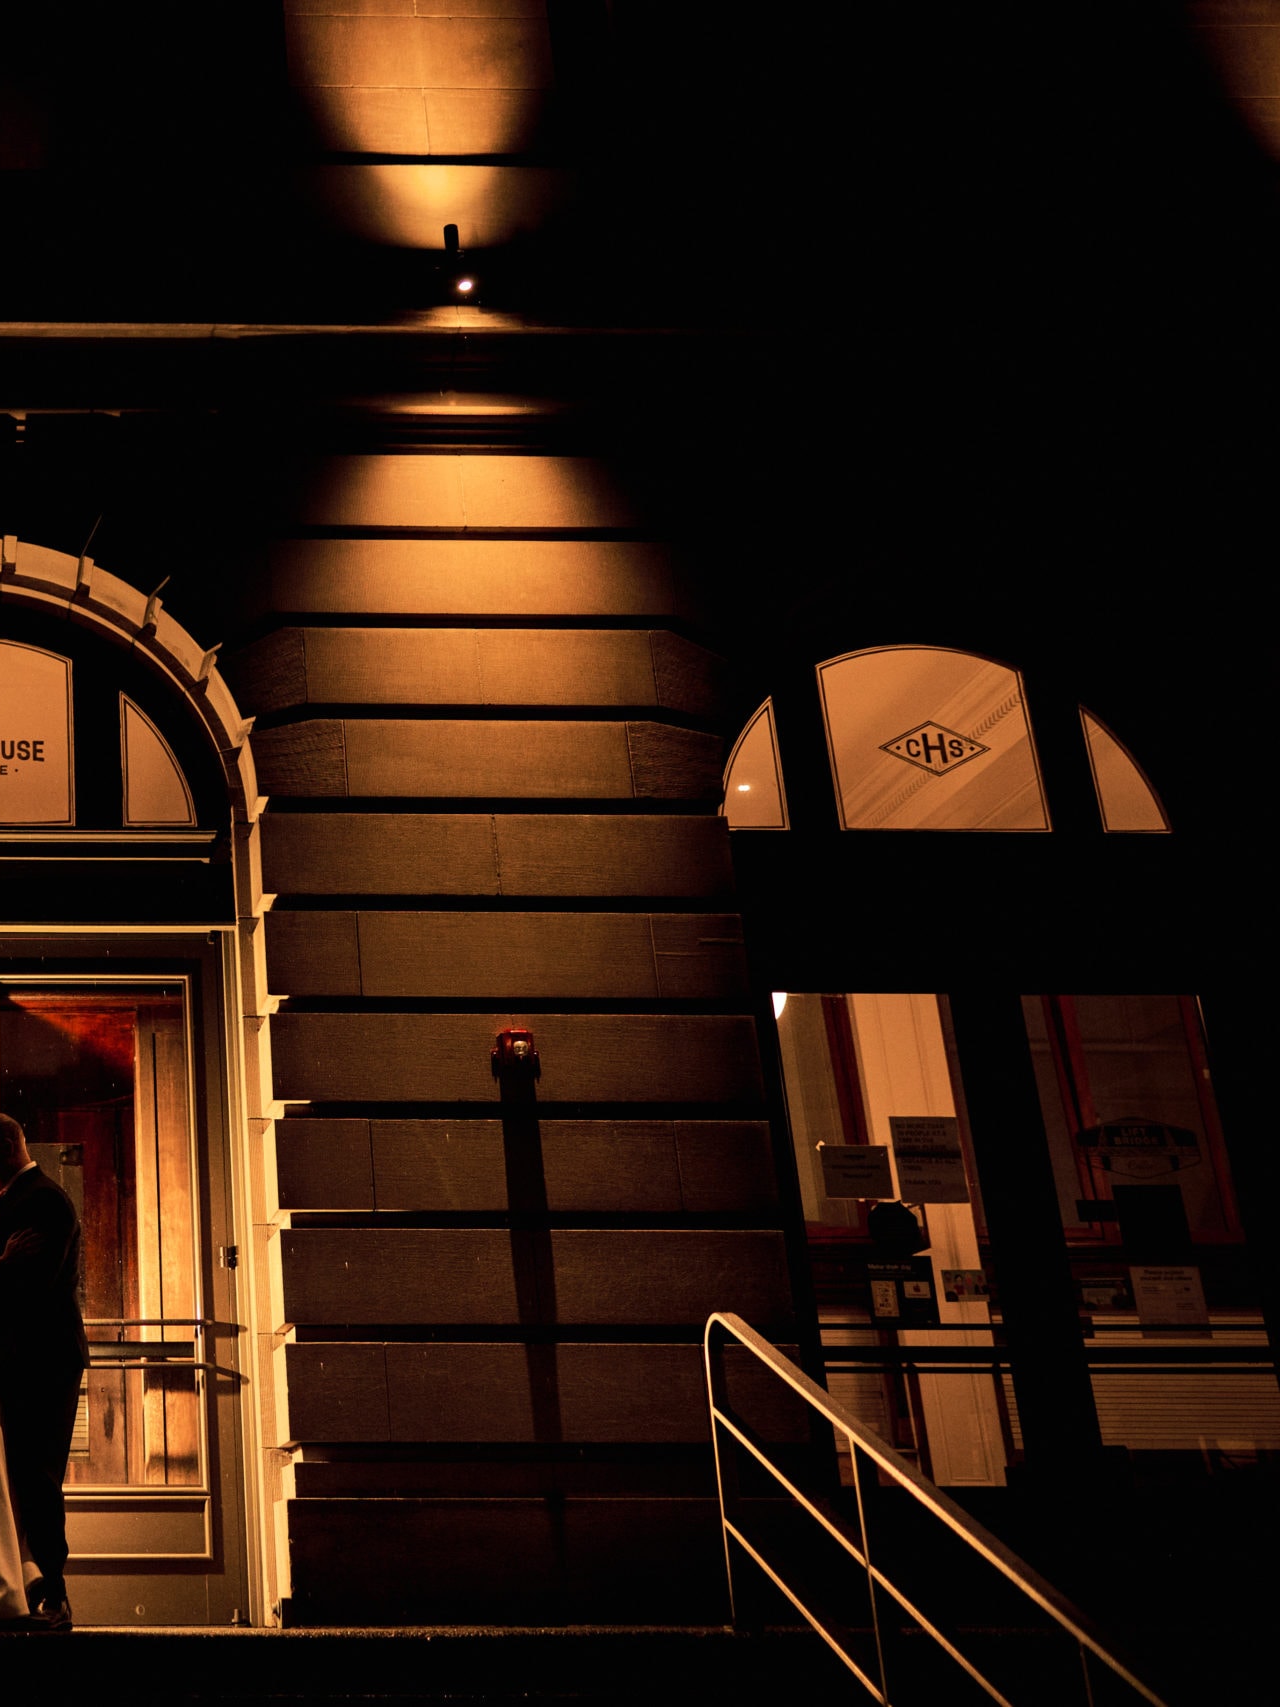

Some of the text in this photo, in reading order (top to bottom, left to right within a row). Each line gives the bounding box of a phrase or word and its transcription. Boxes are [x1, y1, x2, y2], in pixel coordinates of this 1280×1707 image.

[906, 733, 965, 763] CHS
[1120, 1127, 1147, 1137] LIFT
[1112, 1136, 1161, 1146] BRIDGE
